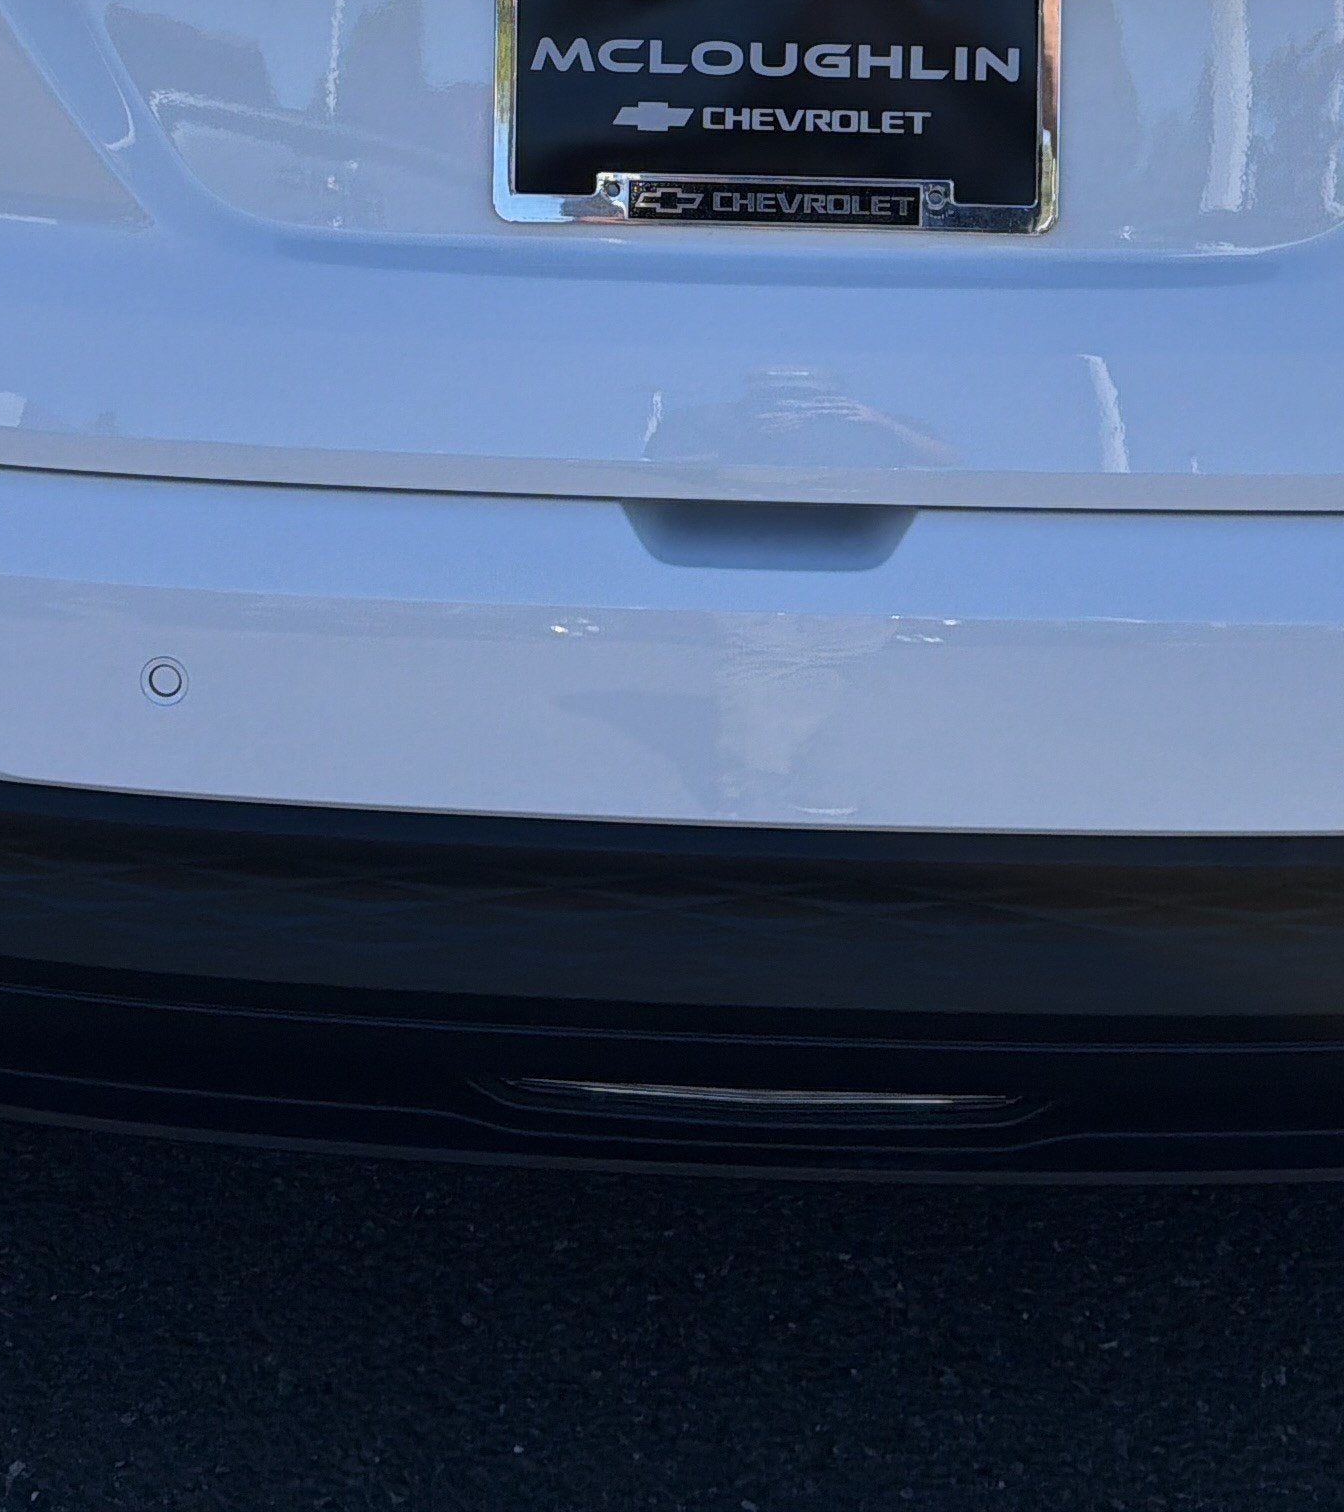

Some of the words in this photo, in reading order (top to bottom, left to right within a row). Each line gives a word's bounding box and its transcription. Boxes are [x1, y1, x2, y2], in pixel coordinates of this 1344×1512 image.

[530, 36, 1020, 82] MCLOUGHLIN
[702, 107, 932, 134] CHEVROLET
[712, 191, 915, 216] CHEVROLET
